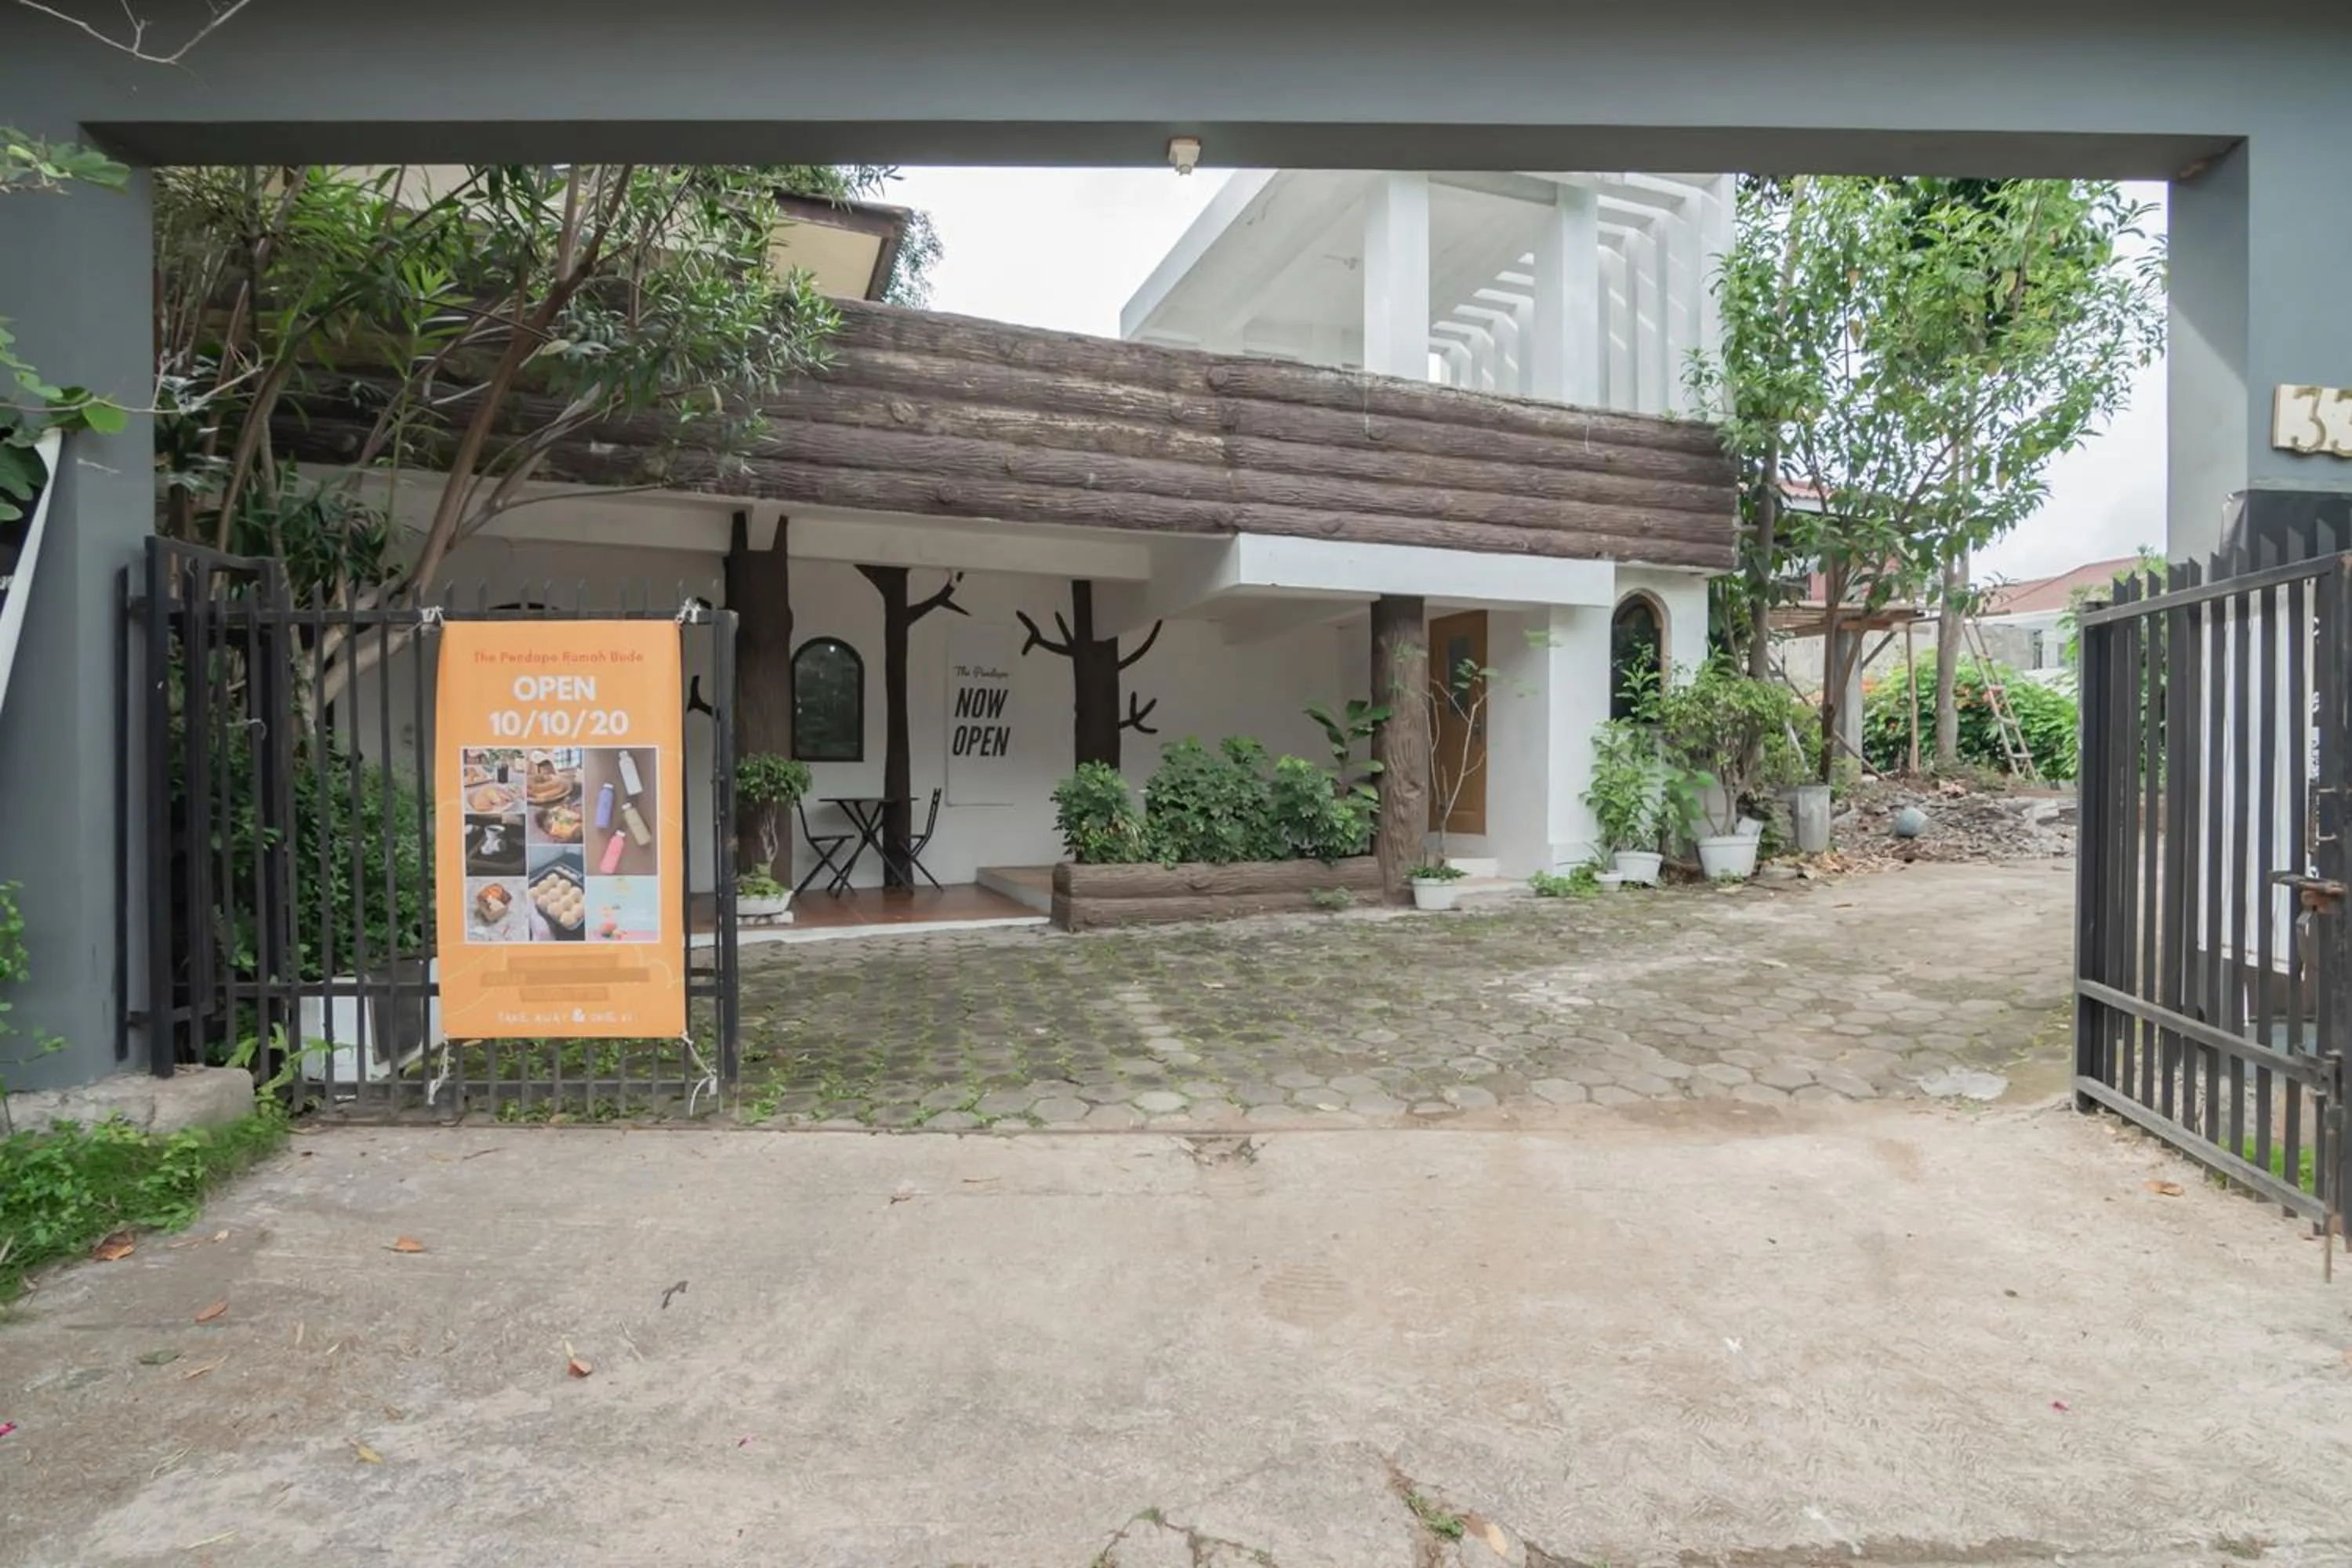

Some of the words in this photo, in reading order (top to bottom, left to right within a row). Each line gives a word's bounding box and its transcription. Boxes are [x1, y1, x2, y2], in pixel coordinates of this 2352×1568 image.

[474, 651, 496, 663] The
[513, 675, 596, 702] OPEN
[955, 687, 1009, 719] NOW
[489, 709, 630, 739] 10/10/20
[953, 724, 1011, 757] OPEN
